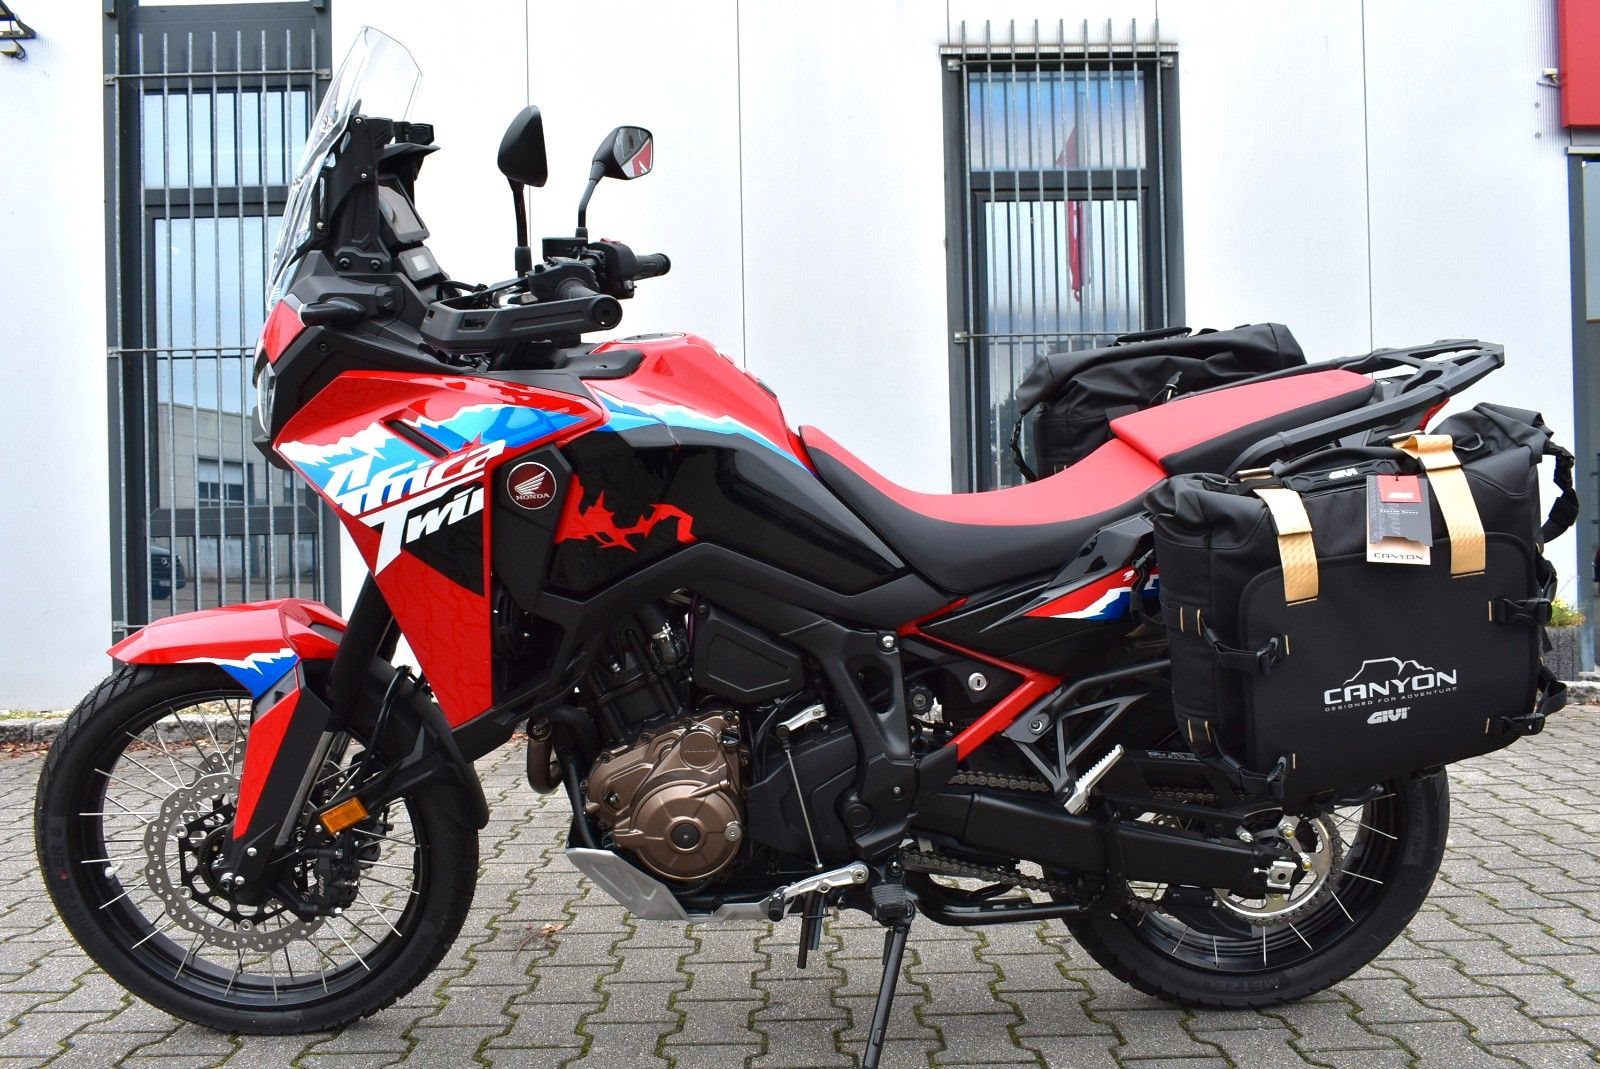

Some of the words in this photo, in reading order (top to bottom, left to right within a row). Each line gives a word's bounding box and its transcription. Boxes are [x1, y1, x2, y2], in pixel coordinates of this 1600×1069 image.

[516, 493, 550, 501] HONDA
[1374, 552, 1423, 560] CANYON
[1324, 669, 1457, 705] CANYON
[1324, 700, 1373, 712] DESIGNED
[1401, 687, 1457, 700] ADVENTURE
[1367, 707, 1409, 724] GIVI
